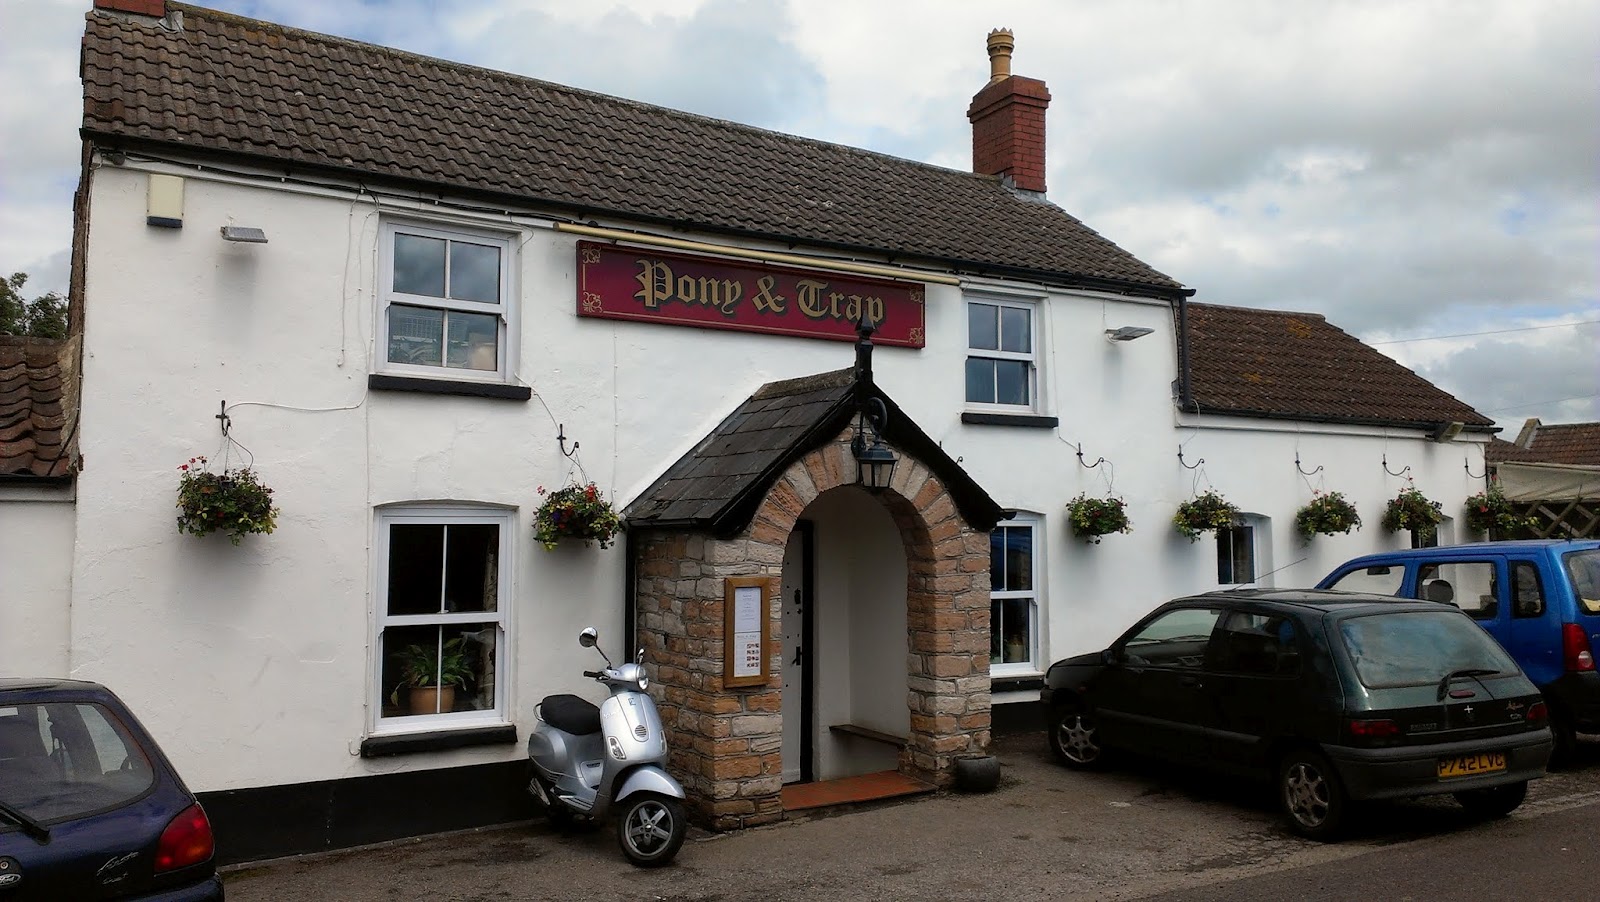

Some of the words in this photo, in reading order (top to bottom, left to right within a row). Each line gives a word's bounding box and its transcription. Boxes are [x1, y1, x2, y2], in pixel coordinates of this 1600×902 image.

[633, 258, 742, 315] Pony
[751, 275, 785, 313] &
[796, 279, 884, 327] Trap
